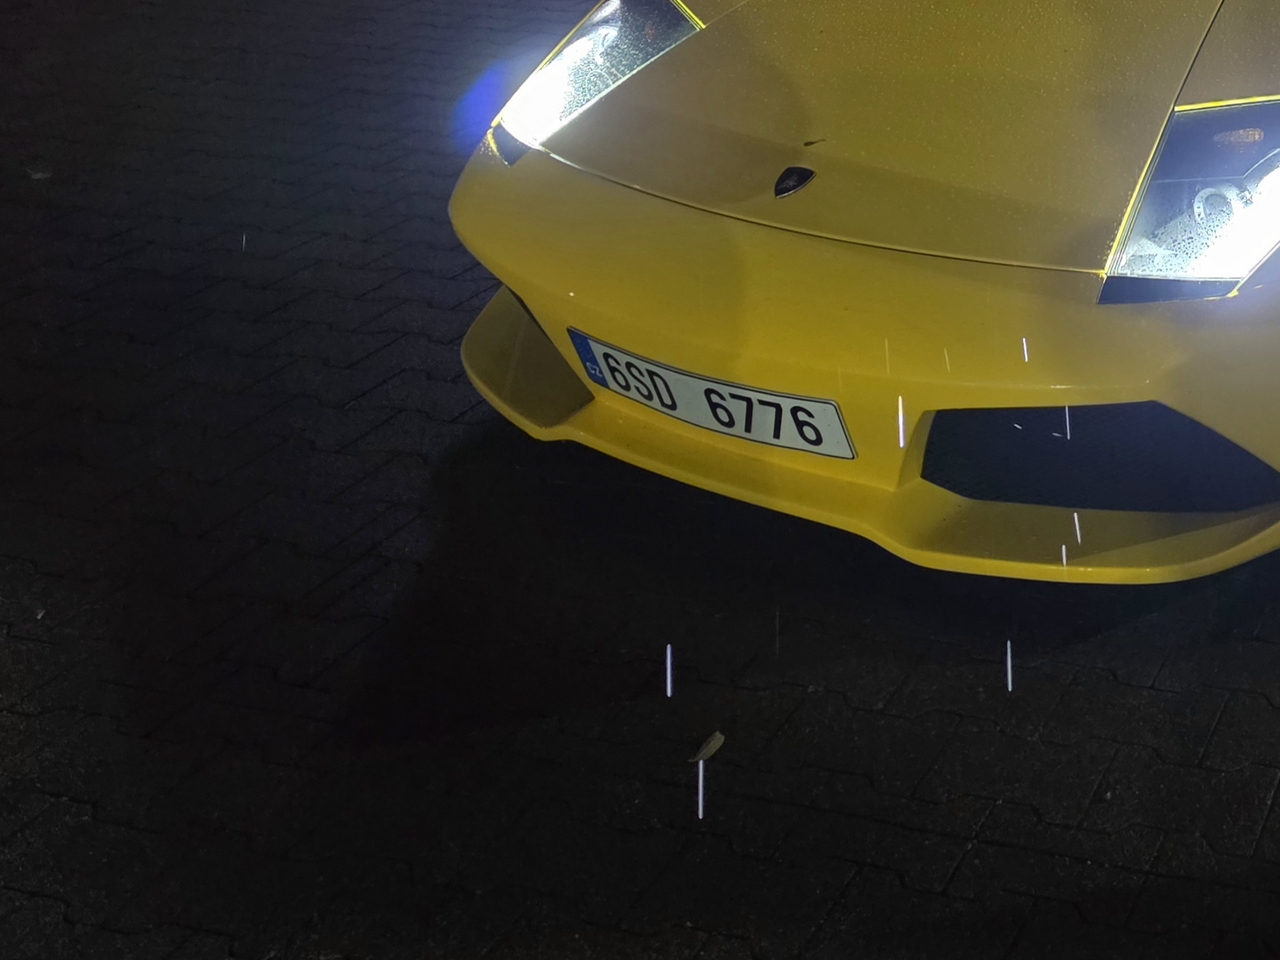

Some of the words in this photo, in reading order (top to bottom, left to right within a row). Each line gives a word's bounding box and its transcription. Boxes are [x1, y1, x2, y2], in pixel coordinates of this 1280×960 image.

[585, 361, 604, 378] CZ
[602, 351, 678, 412] 6SD
[703, 387, 824, 447] 6776
